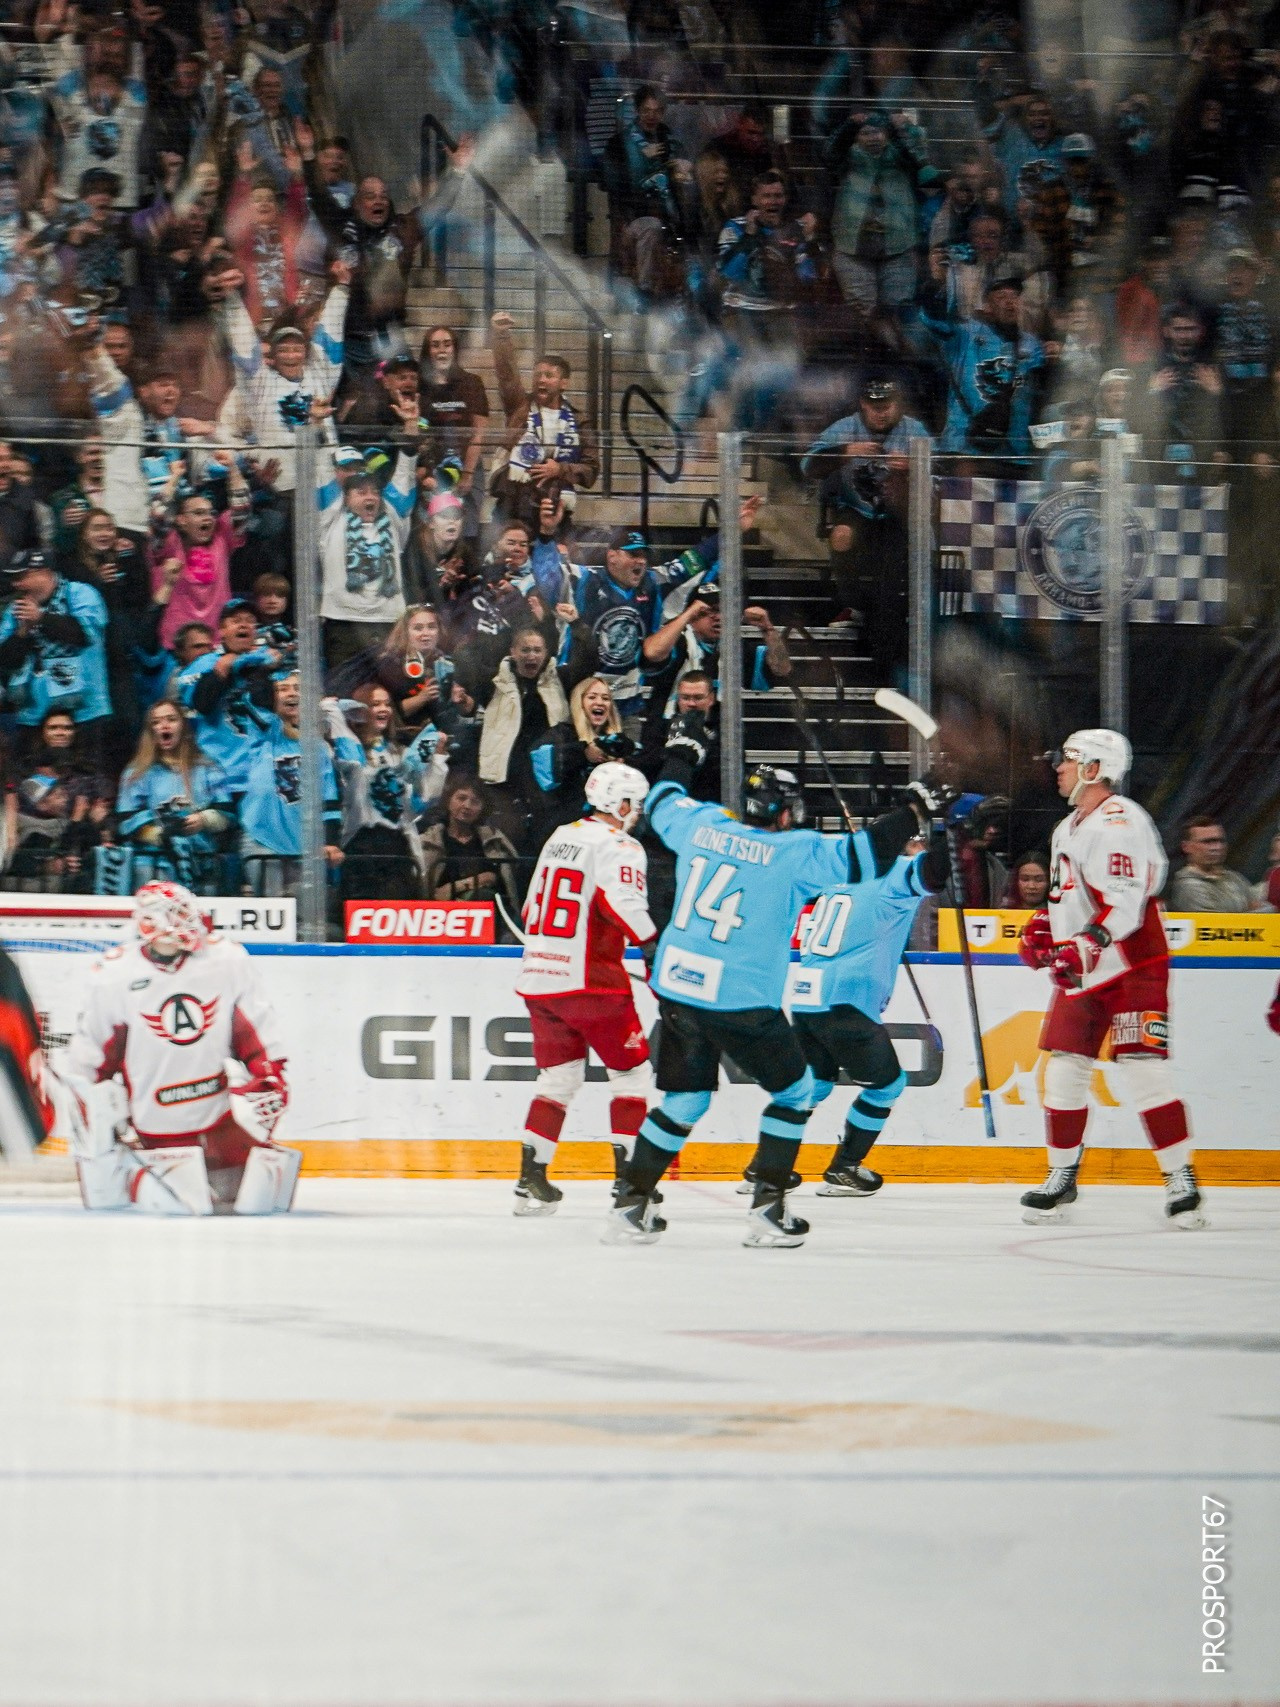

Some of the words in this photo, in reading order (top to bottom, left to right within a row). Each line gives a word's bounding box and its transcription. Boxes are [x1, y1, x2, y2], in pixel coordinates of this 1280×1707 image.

[674, 855, 746, 943] 14
[348, 908, 492, 937] FONBET
[1197, 927, 1265, 942] БАНК
